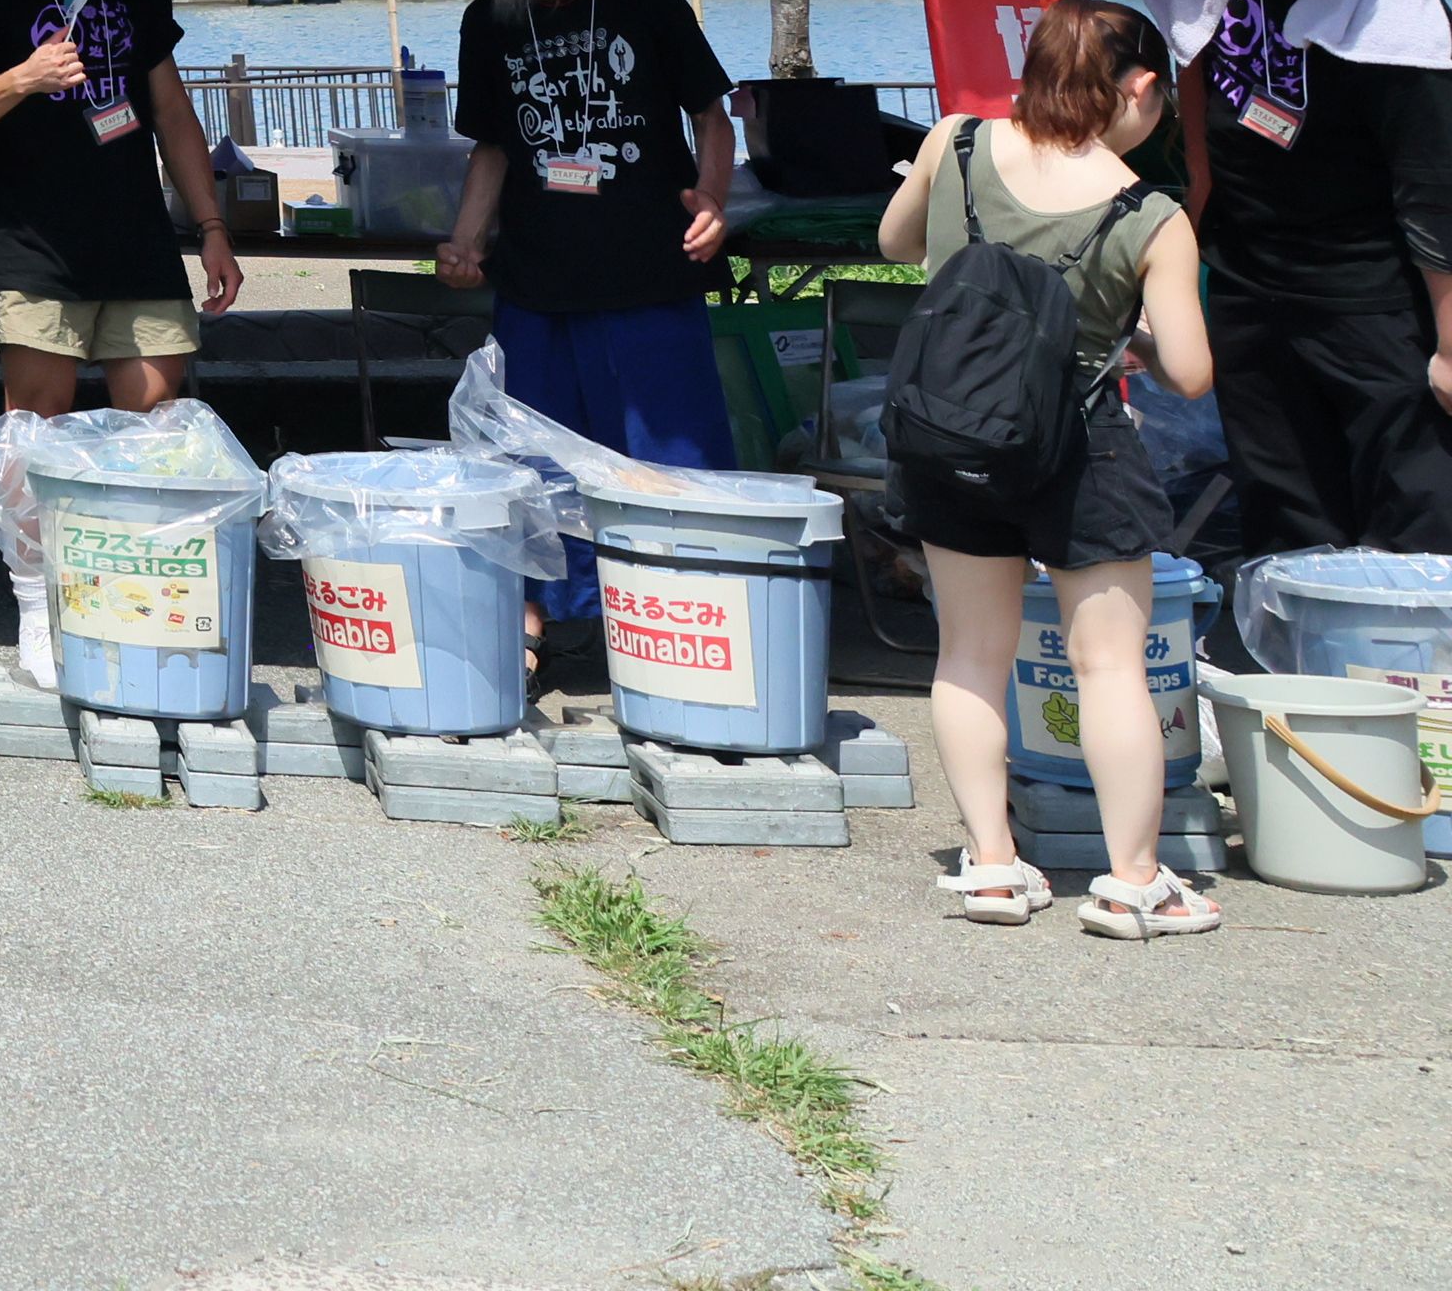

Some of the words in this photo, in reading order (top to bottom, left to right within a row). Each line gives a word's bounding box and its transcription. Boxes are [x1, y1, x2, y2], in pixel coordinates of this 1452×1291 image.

[528, 56, 606, 103] Earth
[552, 170, 581, 180] STAFF
[64, 526, 206, 557] プラスチック
[66, 548, 204, 577] Plastics
[304, 570, 388, 612] えるごみ
[603, 582, 727, 627] 燃えるごみ
[311, 612, 391, 652] nable
[608, 619, 727, 669] Burnable
[1038, 629, 1171, 661] 生み
[1033, 666, 1078, 688] Foo
[1147, 672, 1181, 692] aps
